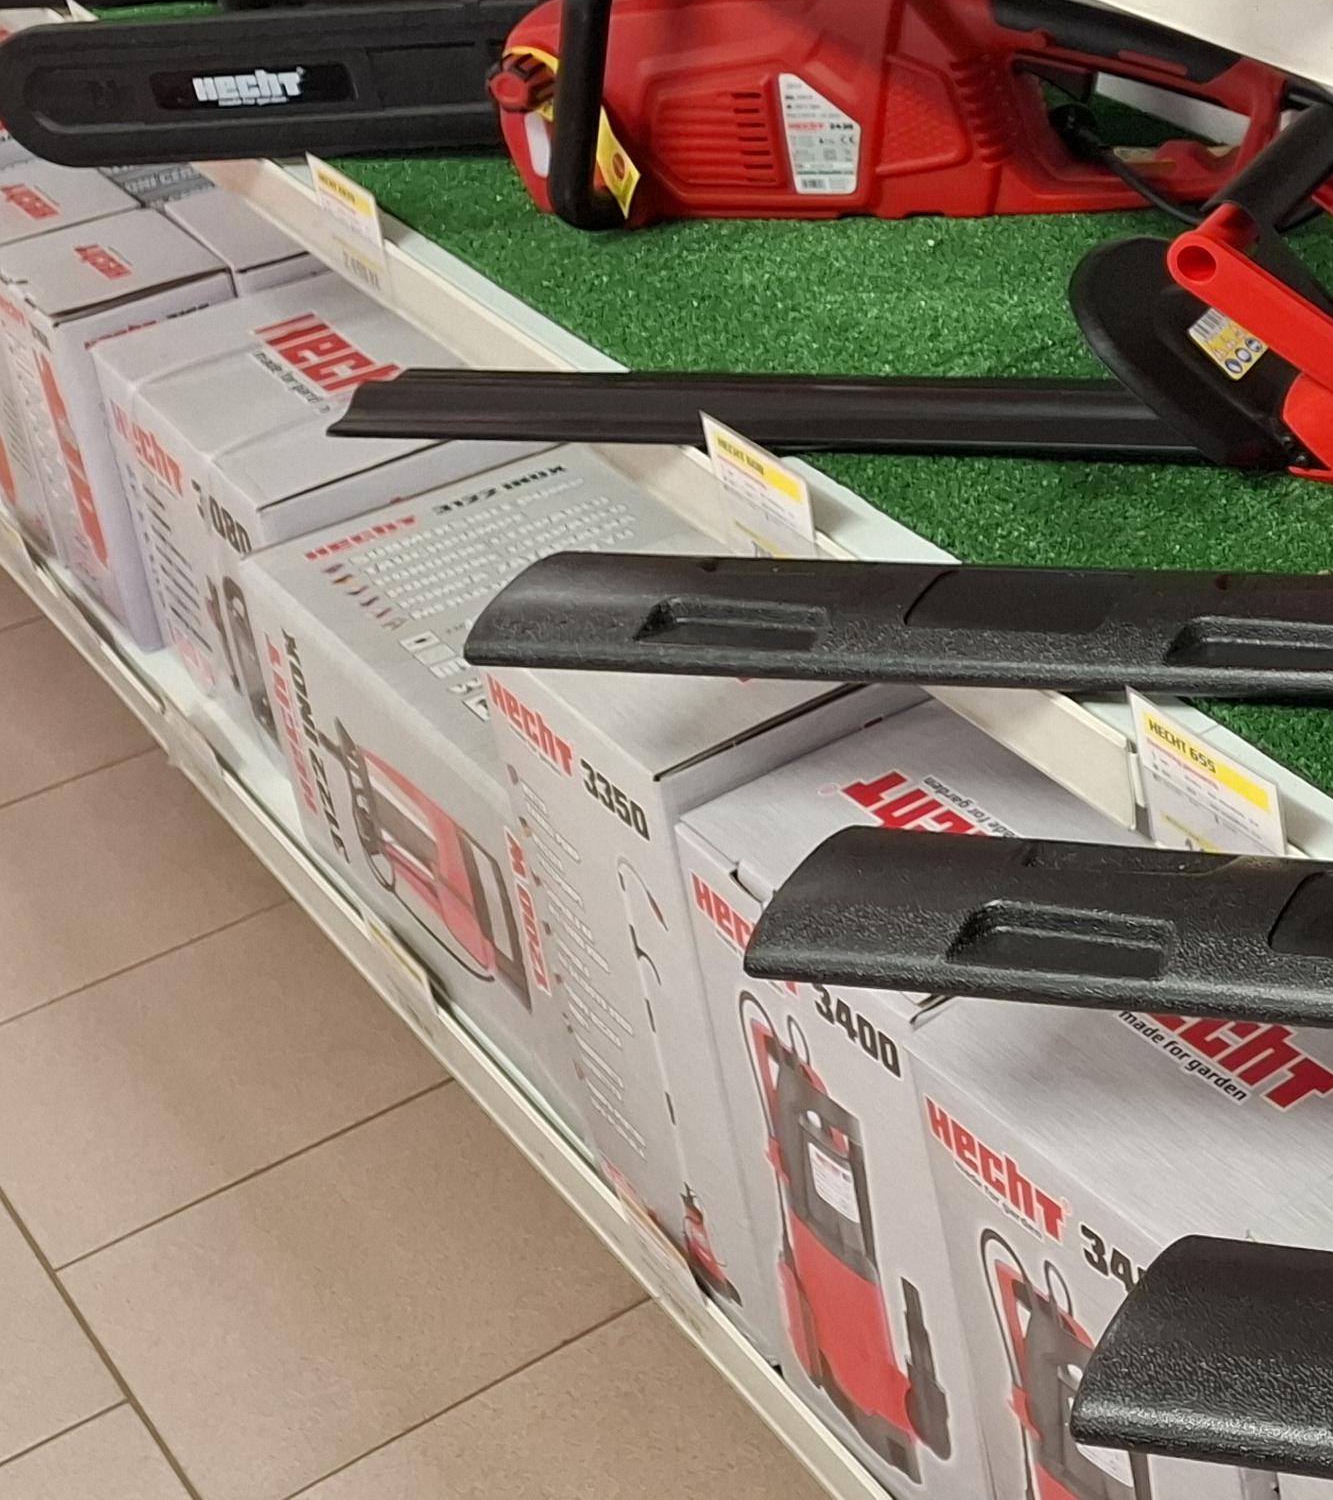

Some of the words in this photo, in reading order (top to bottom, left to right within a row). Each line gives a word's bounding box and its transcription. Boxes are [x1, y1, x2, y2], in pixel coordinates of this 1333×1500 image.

[1148, 719, 1187, 754] HECHT
[1189, 746, 1217, 774] 655
[581, 757, 650, 842] 3350
[812, 983, 901, 1078] 3400
[1118, 1011, 1165, 1045] made
[1162, 1040, 1191, 1064] for
[1184, 1058, 1248, 1102] garden
[1080, 1223, 1148, 1293] 34
